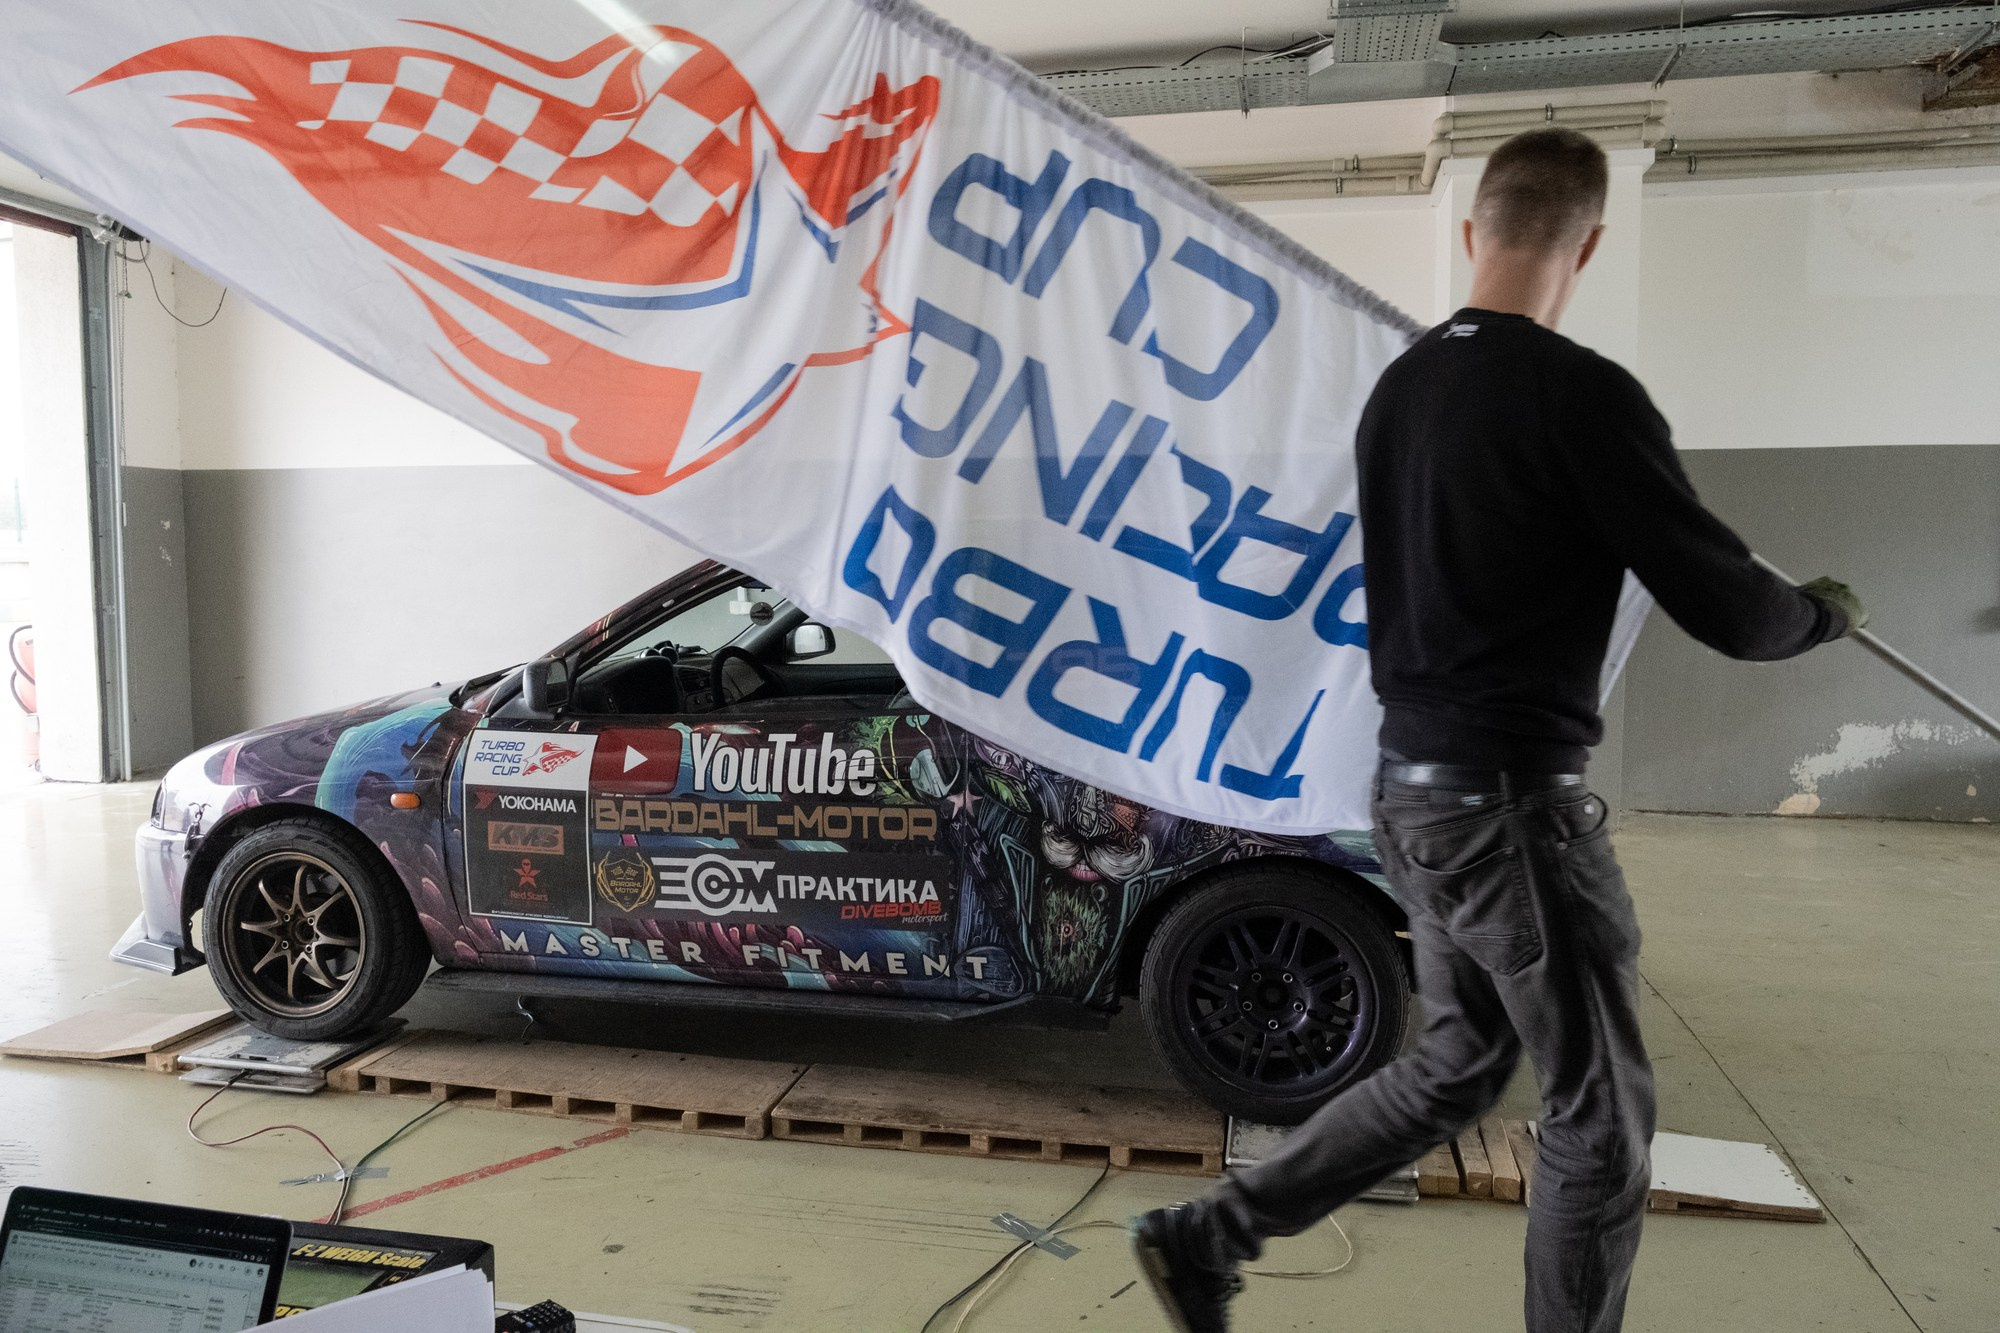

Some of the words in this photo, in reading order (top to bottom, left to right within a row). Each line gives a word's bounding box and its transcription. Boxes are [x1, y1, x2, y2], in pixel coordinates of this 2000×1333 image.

[928, 149, 1280, 402] CUP
[843, 484, 1325, 798] TURBO
[481, 740, 526, 751] TURBO
[474, 752, 523, 763] RACING
[690, 731, 877, 797] YouTube
[492, 766, 520, 776] CUP
[499, 795, 577, 813] YOKOHAMA
[595, 799, 937, 841] BARDAHL-MOTOR
[510, 891, 527, 900] Red
[528, 892, 548, 901] Stars
[777, 875, 940, 904] ПРАКТИКА
[841, 901, 942, 920] DIVEBOMB
[902, 912, 949, 925] motorsport
[500, 930, 704, 964] MASTER
[744, 944, 988, 979] FITMENT
[291, 1243, 328, 1257] E-Z
[317, 1246, 381, 1263] WEIGH
[372, 1251, 428, 1269] Scale
